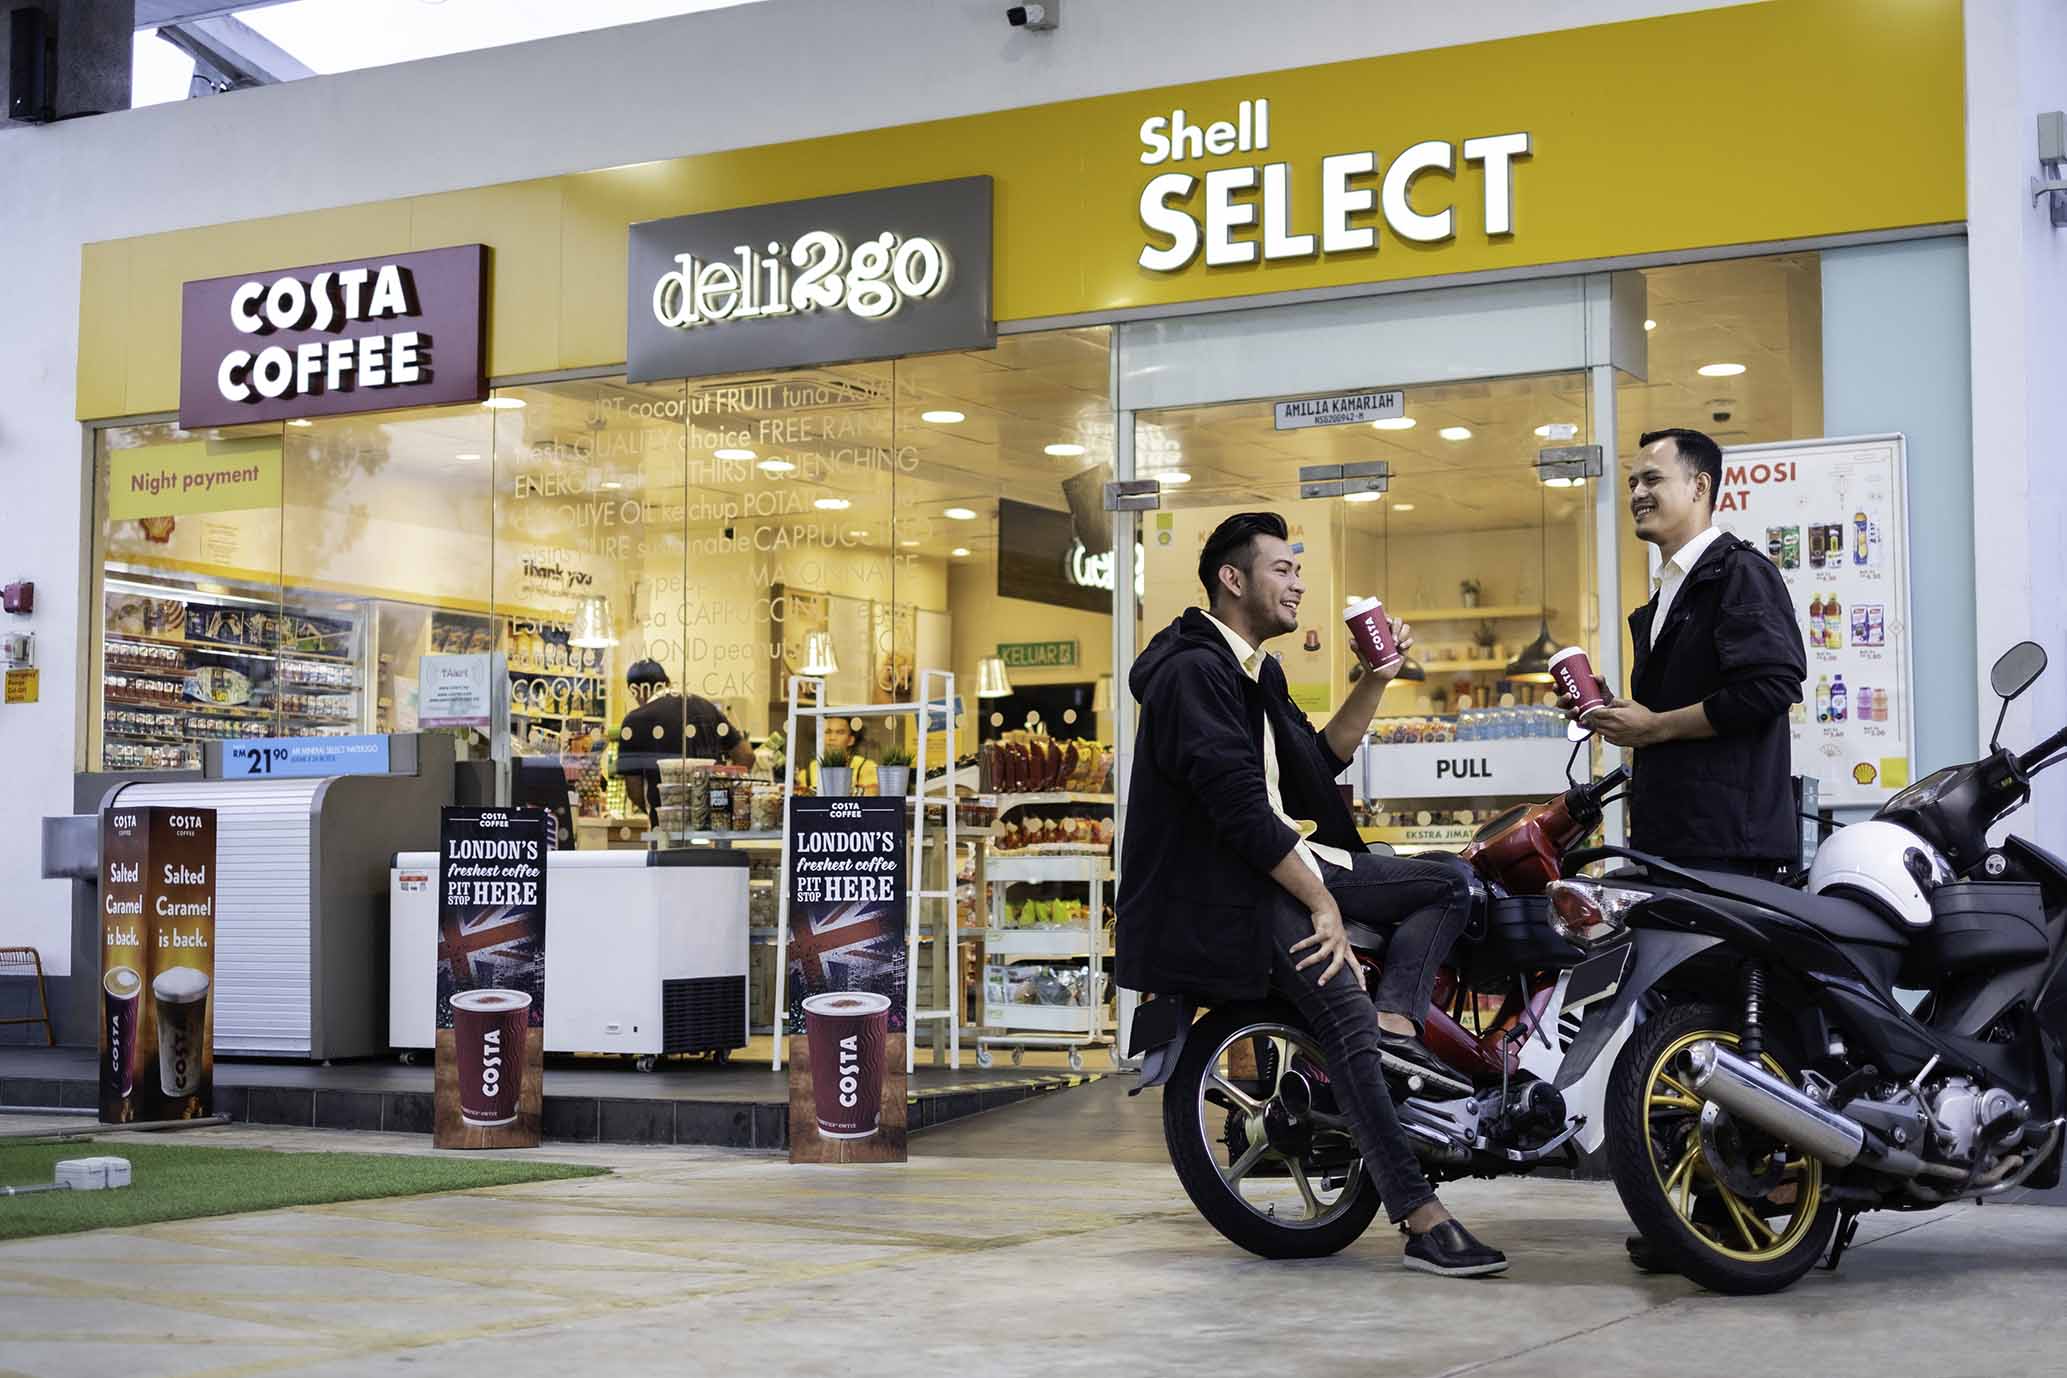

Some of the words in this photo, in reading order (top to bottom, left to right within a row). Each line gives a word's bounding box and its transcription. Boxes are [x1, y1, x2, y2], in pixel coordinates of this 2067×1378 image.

[1139, 99, 1270, 165] Shell
[1137, 132, 1532, 272] SELECT
[652, 231, 943, 328] deli2go
[230, 264, 408, 334] COSTA
[217, 331, 421, 402] COFFEE
[628, 393, 711, 418] coconut
[716, 384, 776, 414] FRUIT
[782, 387, 829, 408] tuna
[1285, 400, 1329, 418] AMILIA
[1332, 394, 1395, 414] KAMARIAH
[678, 424, 751, 450] choice
[759, 416, 813, 445] FREE
[131, 470, 178, 496] Night
[183, 465, 260, 493] payment
[1365, 616, 1385, 651] COSTA
[1002, 645, 1057, 666] KELUAR
[1560, 667, 1581, 699] COSTA
[232, 749, 247, 759] RM
[247, 748, 272, 774] 21
[272, 748, 289, 761] 90
[1436, 758, 1493, 779] PULL
[481, 812, 508, 820] COSTA
[829, 810, 862, 818] COFFEE
[831, 802, 860, 810] COSTA
[113, 815, 137, 828] COSTA
[169, 815, 203, 829] COSTA
[479, 820, 510, 828] COFFEE
[796, 831, 895, 853] LONDON'S
[1405, 829, 1445, 840] EKSTRA
[1446, 829, 1475, 840] JIMAT
[448, 839, 539, 860] LONDON'S
[110, 861, 139, 883] Salted
[163, 863, 206, 885] Salted
[447, 862, 500, 878] freshest
[501, 863, 542, 878] coffee
[796, 856, 854, 873] freshest
[854, 855, 898, 873] coffee
[447, 881, 471, 895] PIT
[472, 881, 538, 906] HERE
[796, 876, 822, 892] PIT
[824, 875, 895, 902] HERE
[796, 892, 822, 902] STOP
[105, 893, 143, 915] Caramel
[155, 895, 212, 917] Caramel
[447, 895, 471, 906] STOP
[107, 927, 115, 945] is
[115, 925, 140, 946] back.
[158, 928, 170, 948] is
[172, 927, 208, 949] back.
[112, 1014, 121, 1072] COSTA
[482, 1029, 502, 1097] COSTA
[839, 1034, 861, 1108] COSTA
